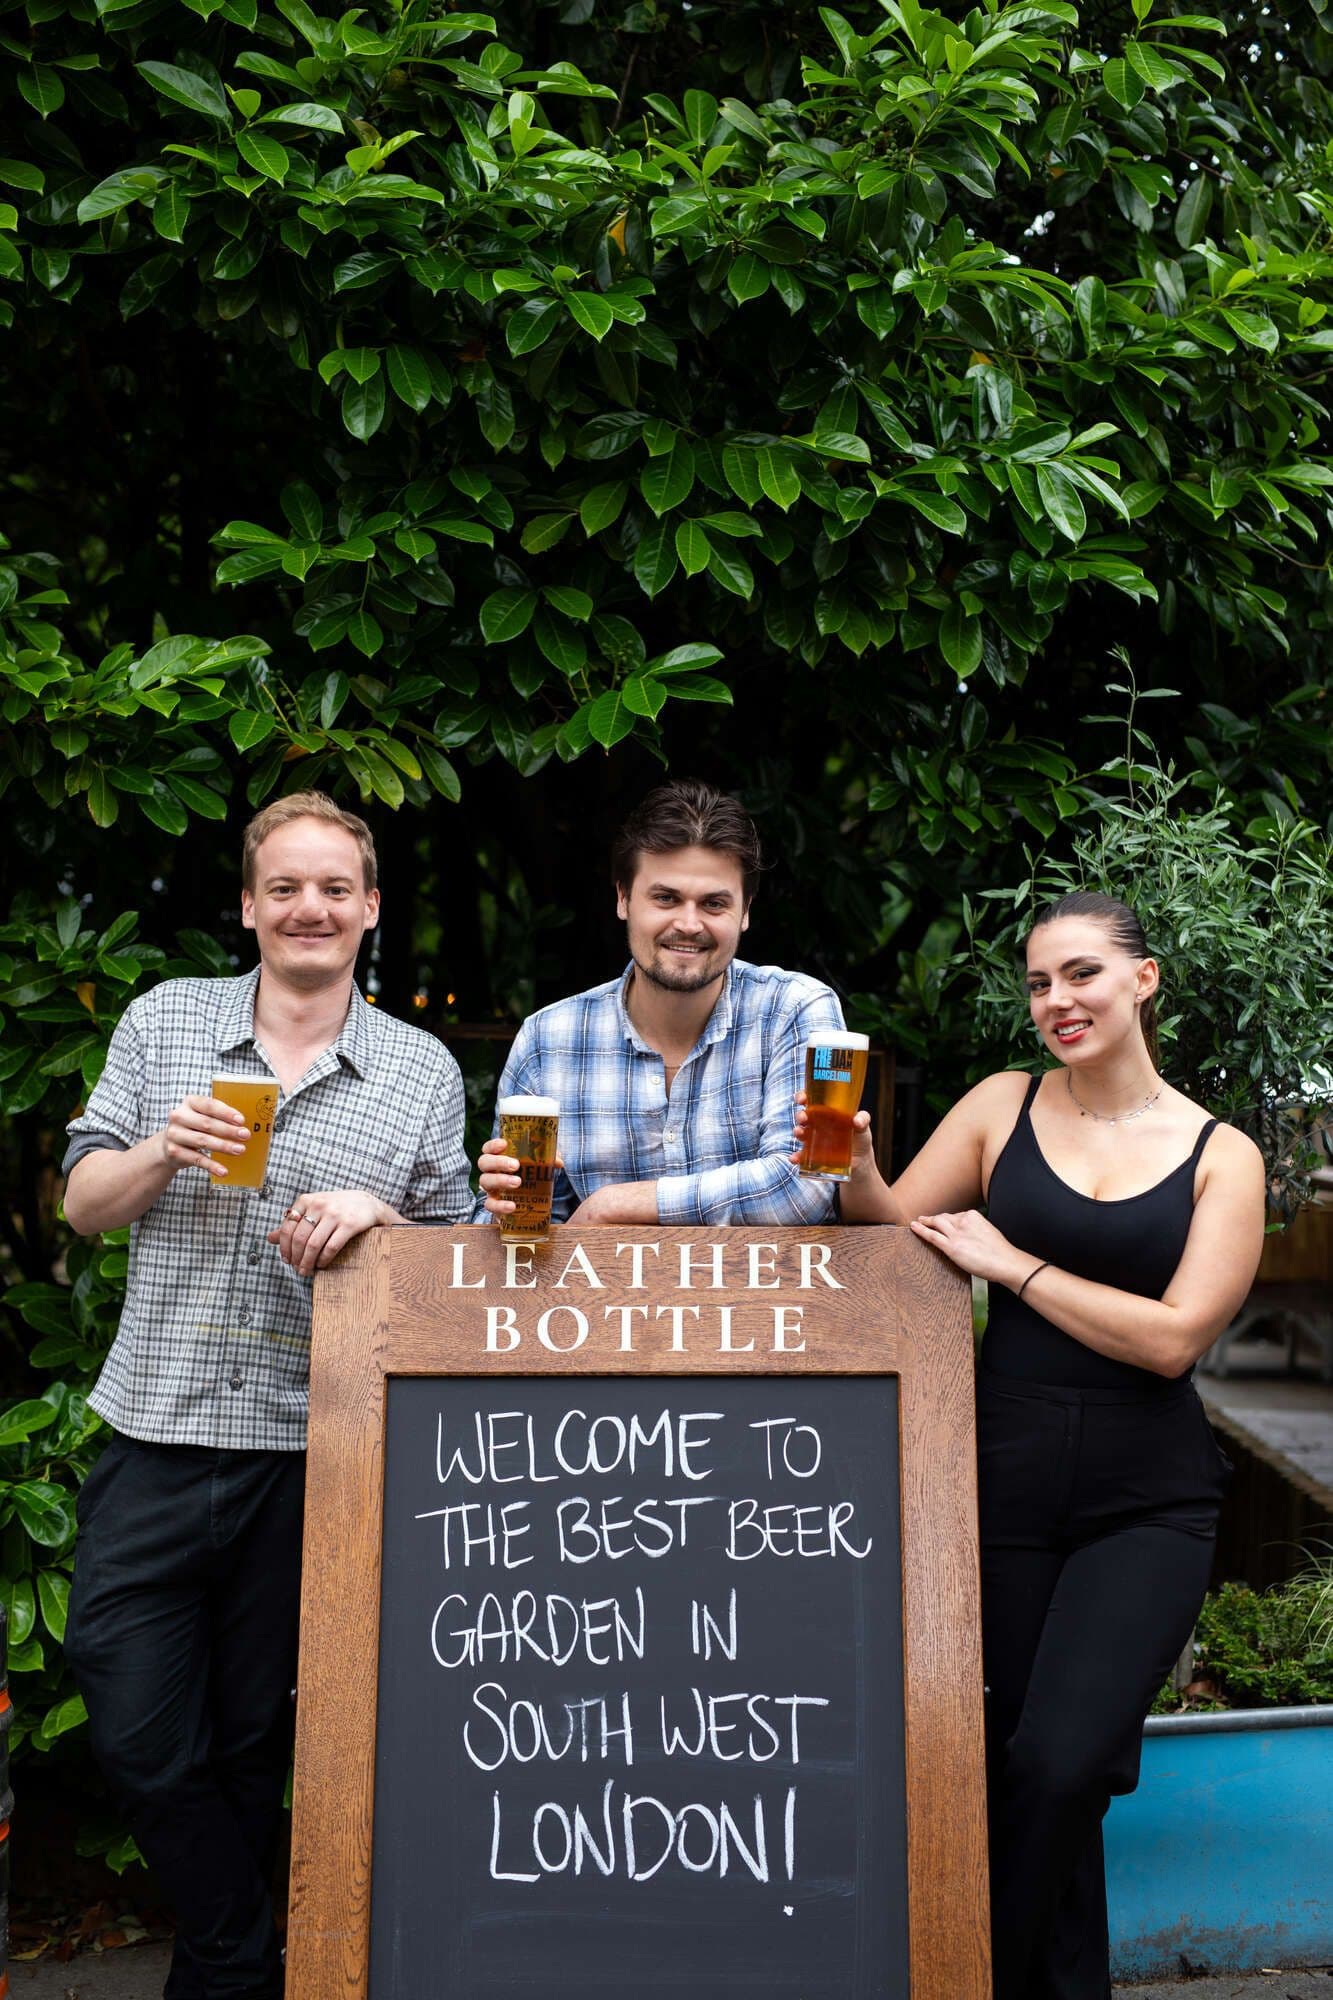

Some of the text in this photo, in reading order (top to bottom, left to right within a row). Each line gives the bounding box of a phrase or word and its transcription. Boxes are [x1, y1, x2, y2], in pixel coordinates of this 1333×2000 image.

[813, 1069, 851, 1082] BARCELONA
[448, 1242, 847, 1289] LEATHER
[482, 1305, 806, 1353] BOTTLE
[436, 1409, 822, 1484] WELCOME TO
[415, 1497, 872, 1569] THE BEST BEER
[431, 1587, 737, 1668] GARDEN IN
[463, 1682, 829, 1770] SOUTH WEST
[489, 1779, 797, 1917] LONDON!
